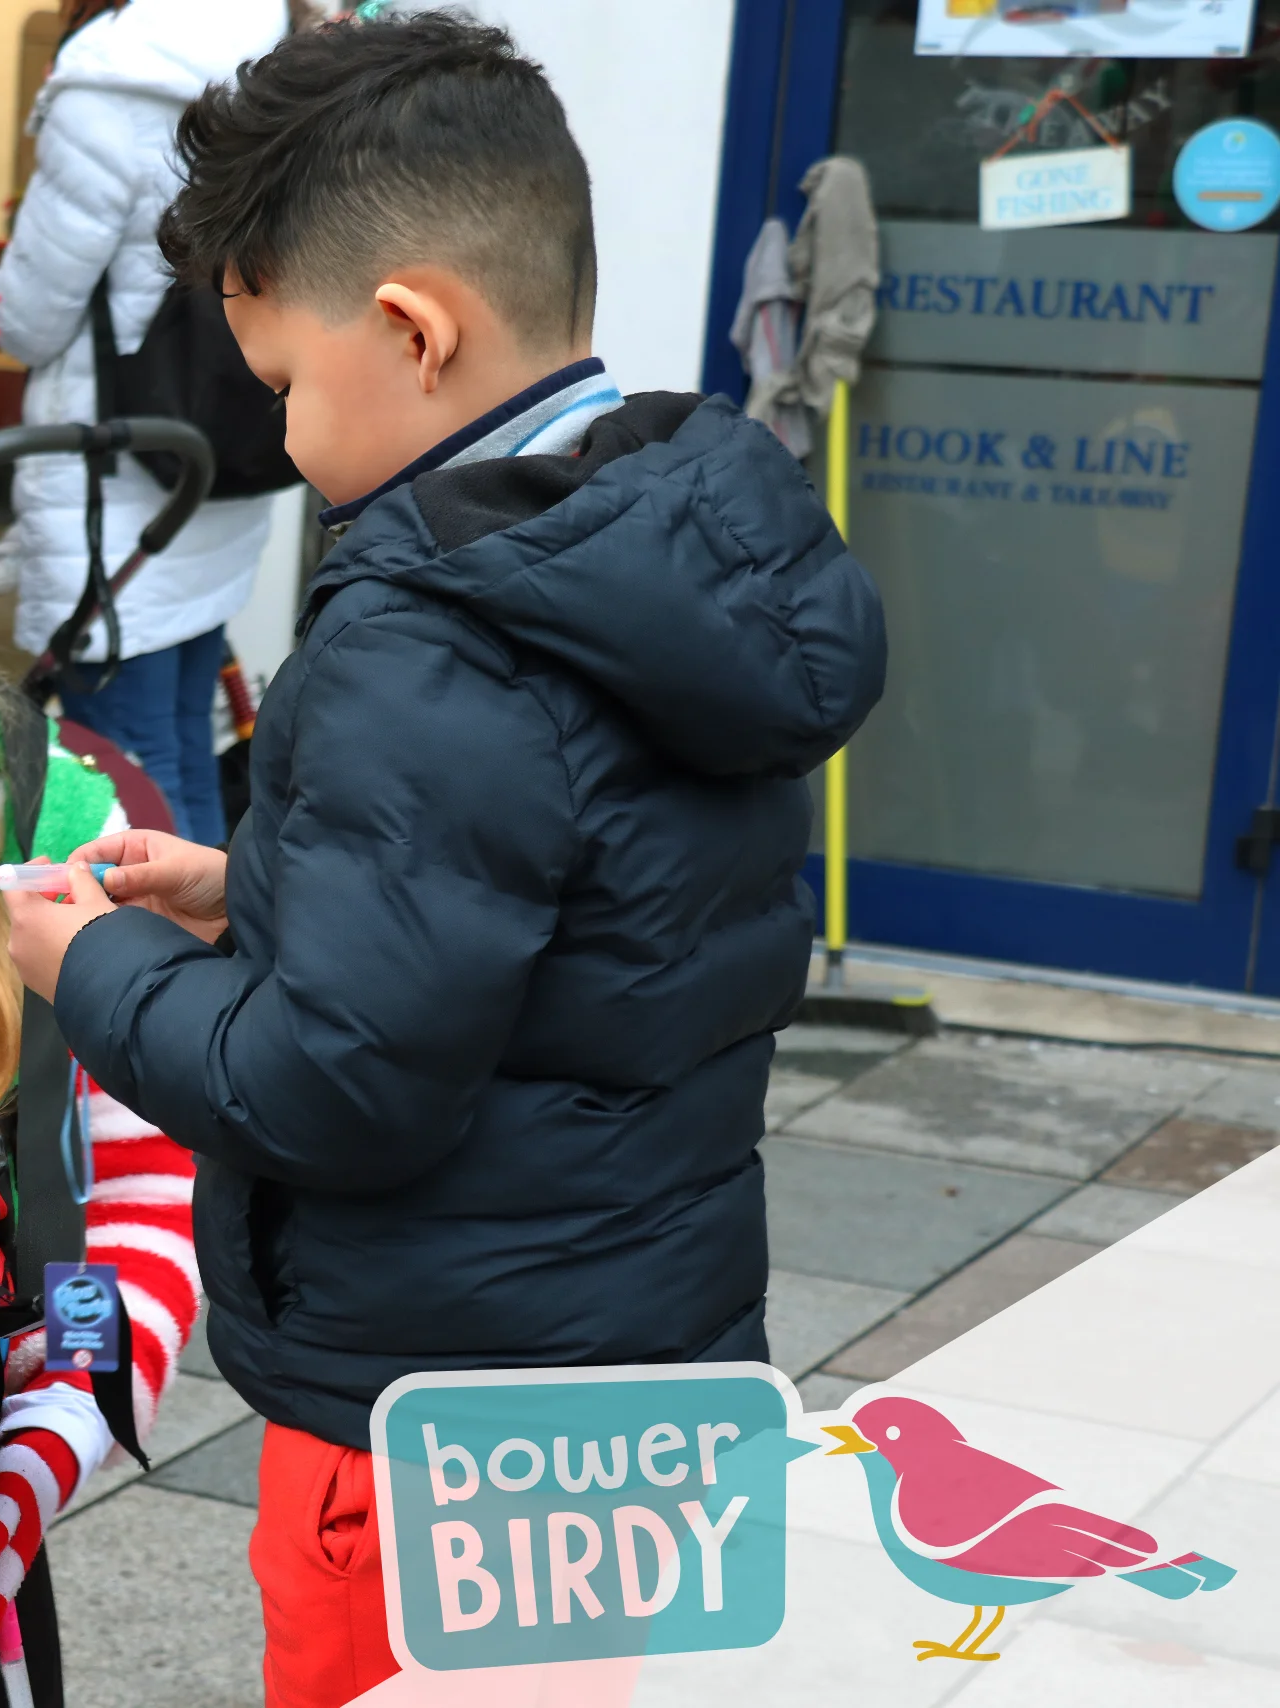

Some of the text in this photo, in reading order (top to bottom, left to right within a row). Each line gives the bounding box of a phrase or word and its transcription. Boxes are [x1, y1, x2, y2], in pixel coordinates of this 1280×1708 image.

[1016, 163, 1090, 190] GONE
[996, 187, 1114, 220] FISHING
[875, 273, 1215, 324] RESTAURANT
[858, 423, 1193, 478] HOOK & LINE
